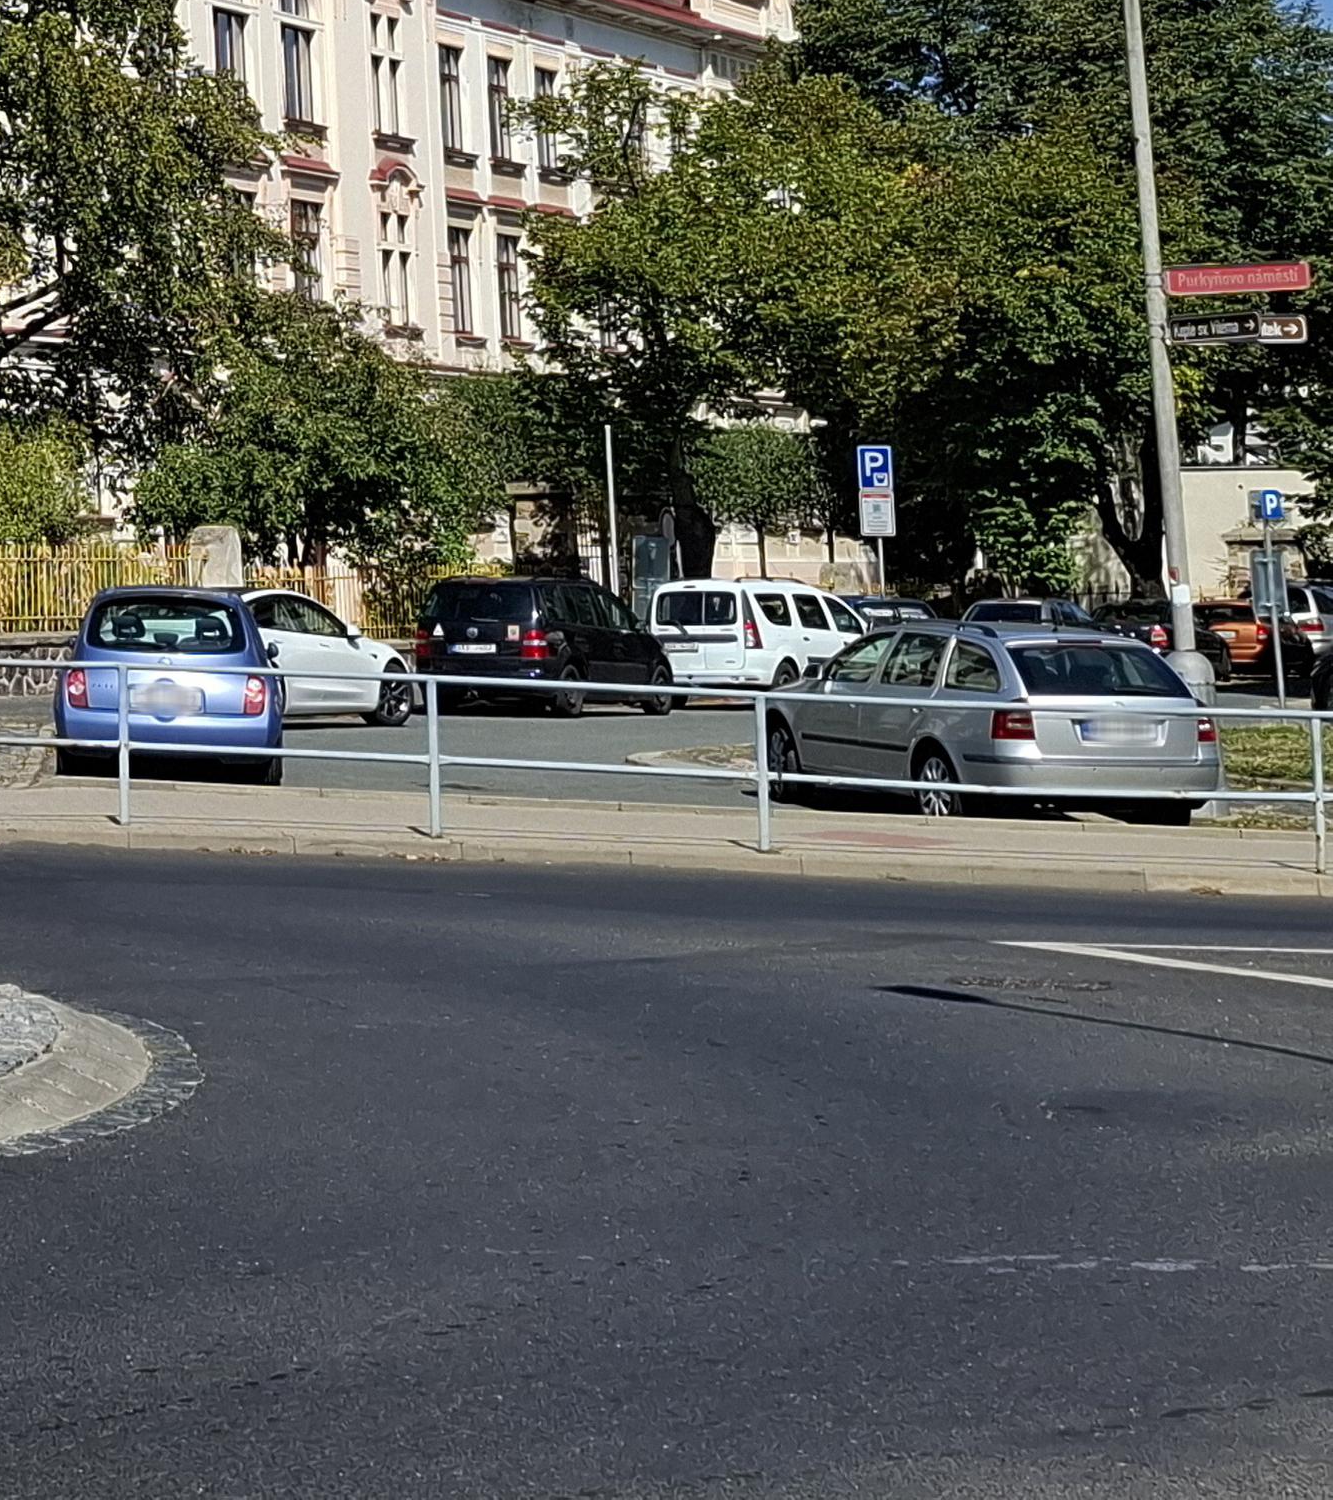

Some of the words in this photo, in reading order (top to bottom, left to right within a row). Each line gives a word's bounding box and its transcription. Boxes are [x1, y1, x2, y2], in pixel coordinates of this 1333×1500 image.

[1178, 272, 1244, 288] Purkyňovo
[1247, 267, 1298, 285] náměstí
[864, 451, 884, 477] P
[1265, 493, 1278, 516] P
